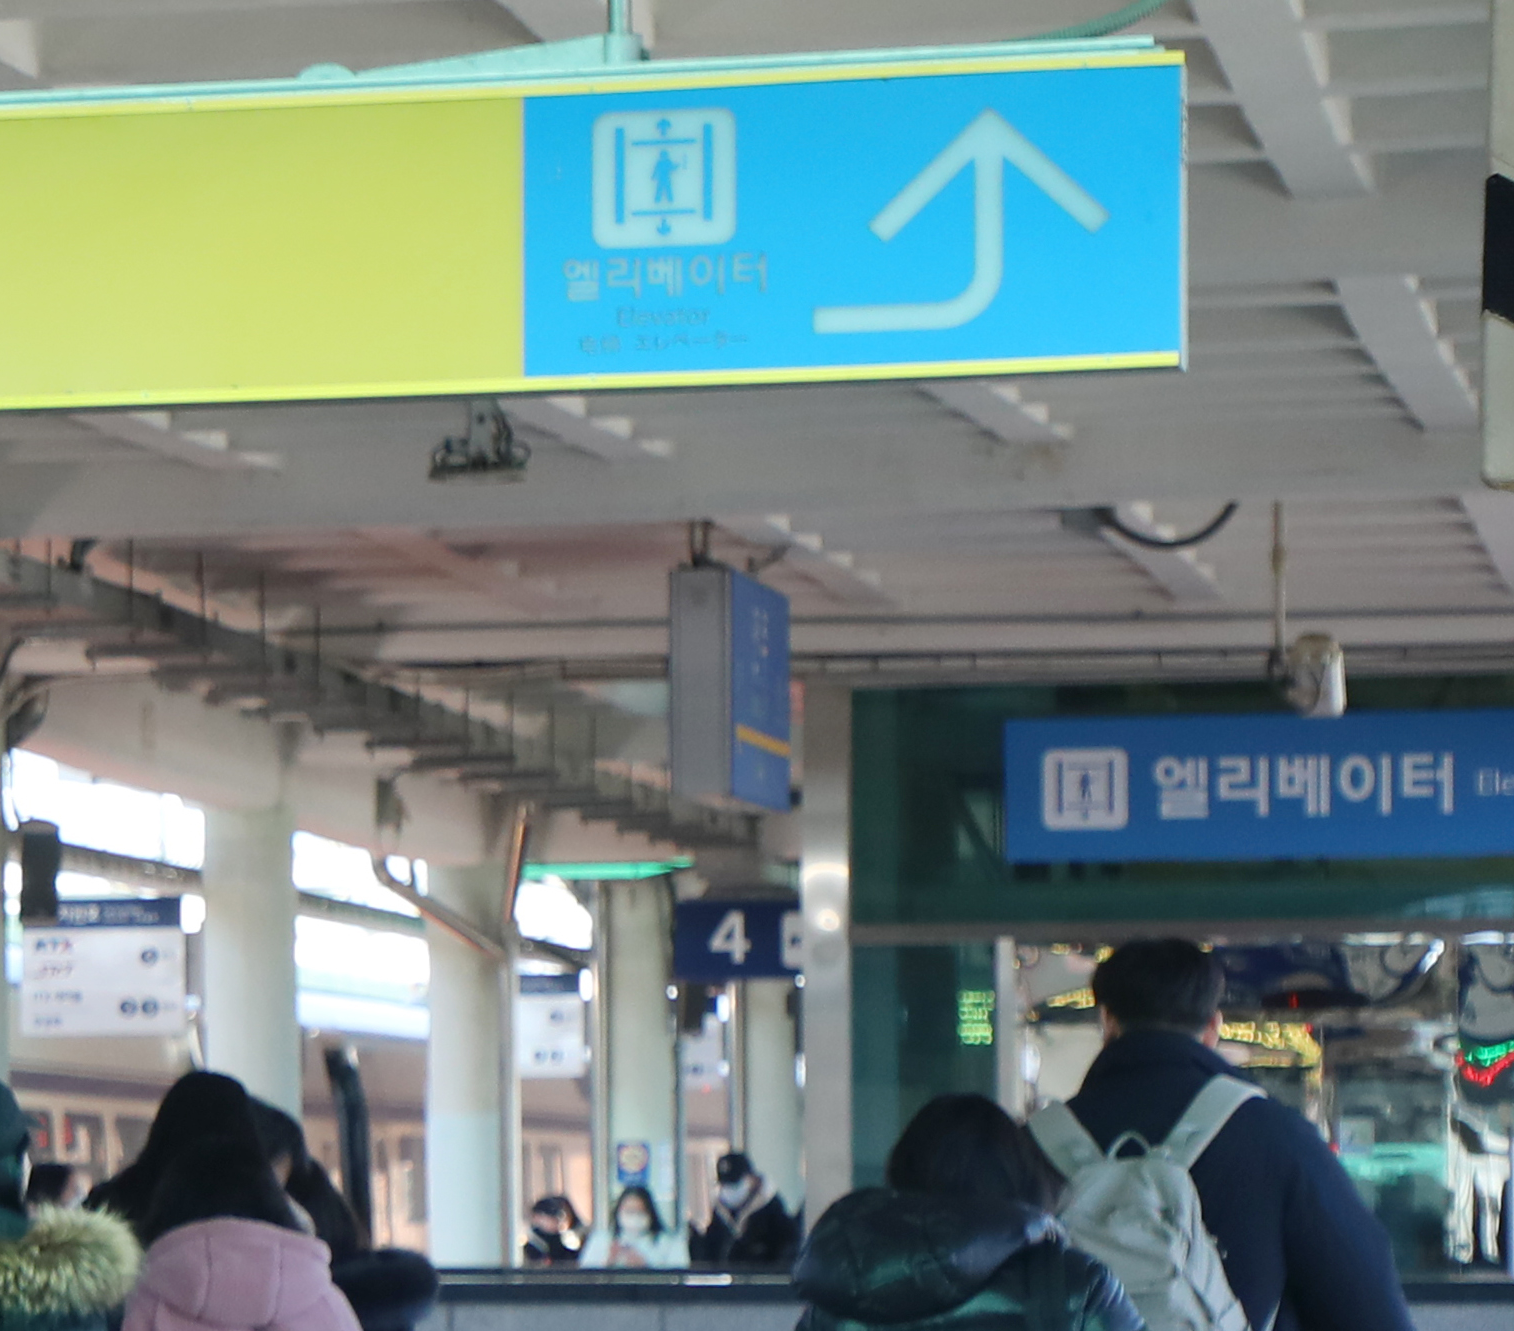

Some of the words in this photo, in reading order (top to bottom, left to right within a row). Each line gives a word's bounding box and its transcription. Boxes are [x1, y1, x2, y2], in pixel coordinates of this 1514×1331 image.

[563, 252, 769, 302] 엘리베이터
[1153, 751, 1456, 821] 엘리베이터
[707, 909, 752, 966] 4
